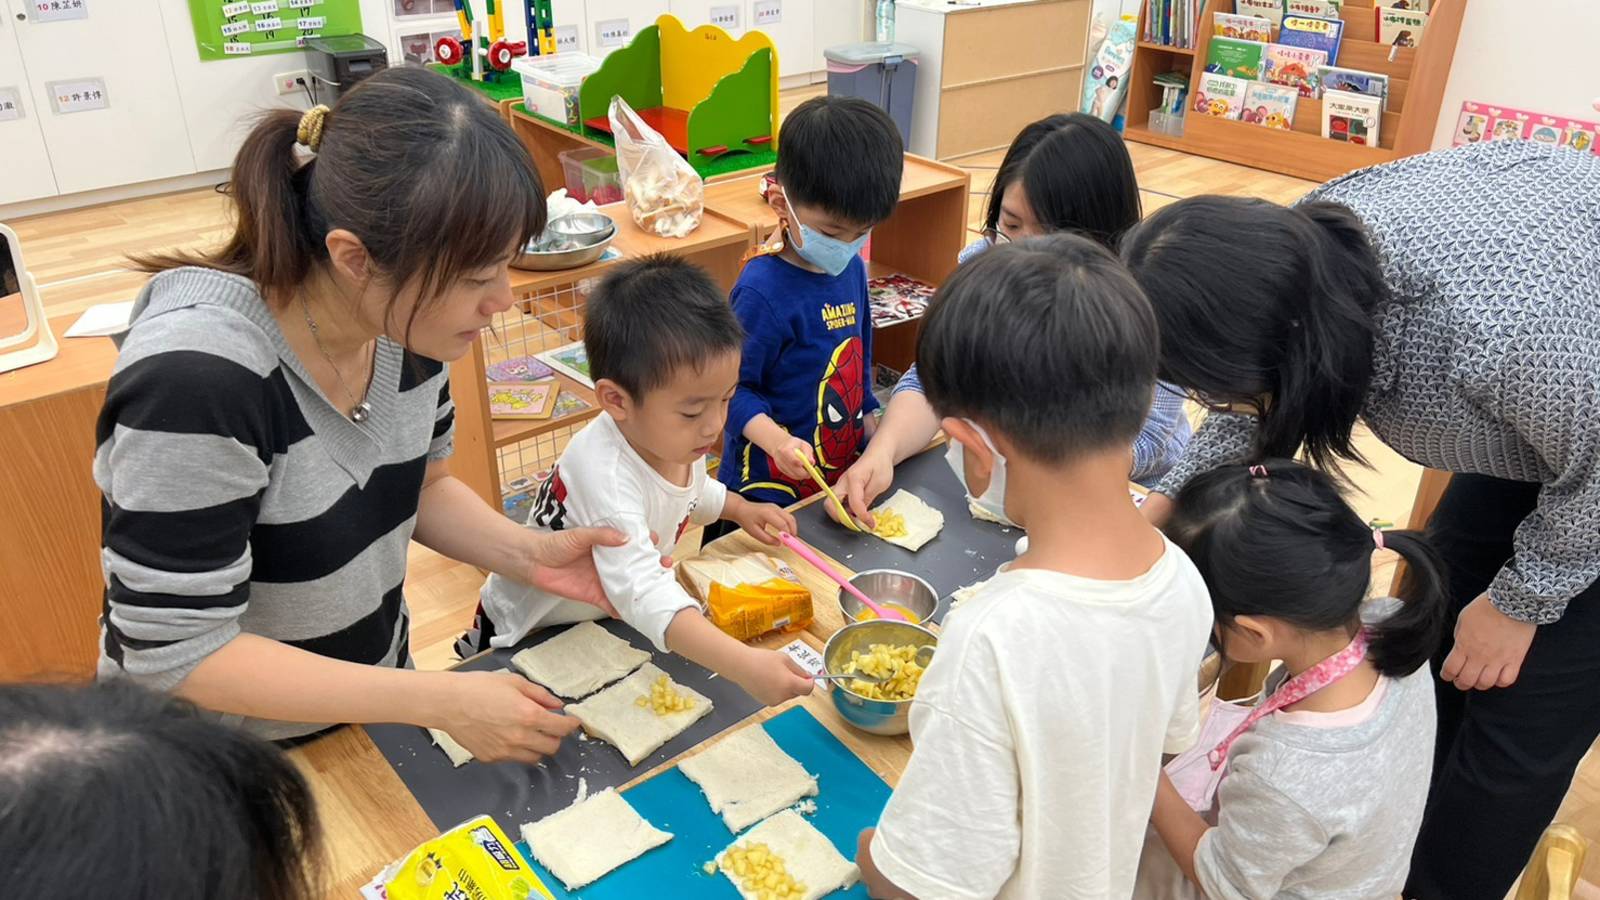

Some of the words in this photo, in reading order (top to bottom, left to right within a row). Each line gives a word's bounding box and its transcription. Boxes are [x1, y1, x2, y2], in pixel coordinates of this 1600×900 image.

[300, 7, 310, 17] 17
[821, 303, 856, 321] AMAZING
[826, 316, 856, 331] SPIDER-MAN
